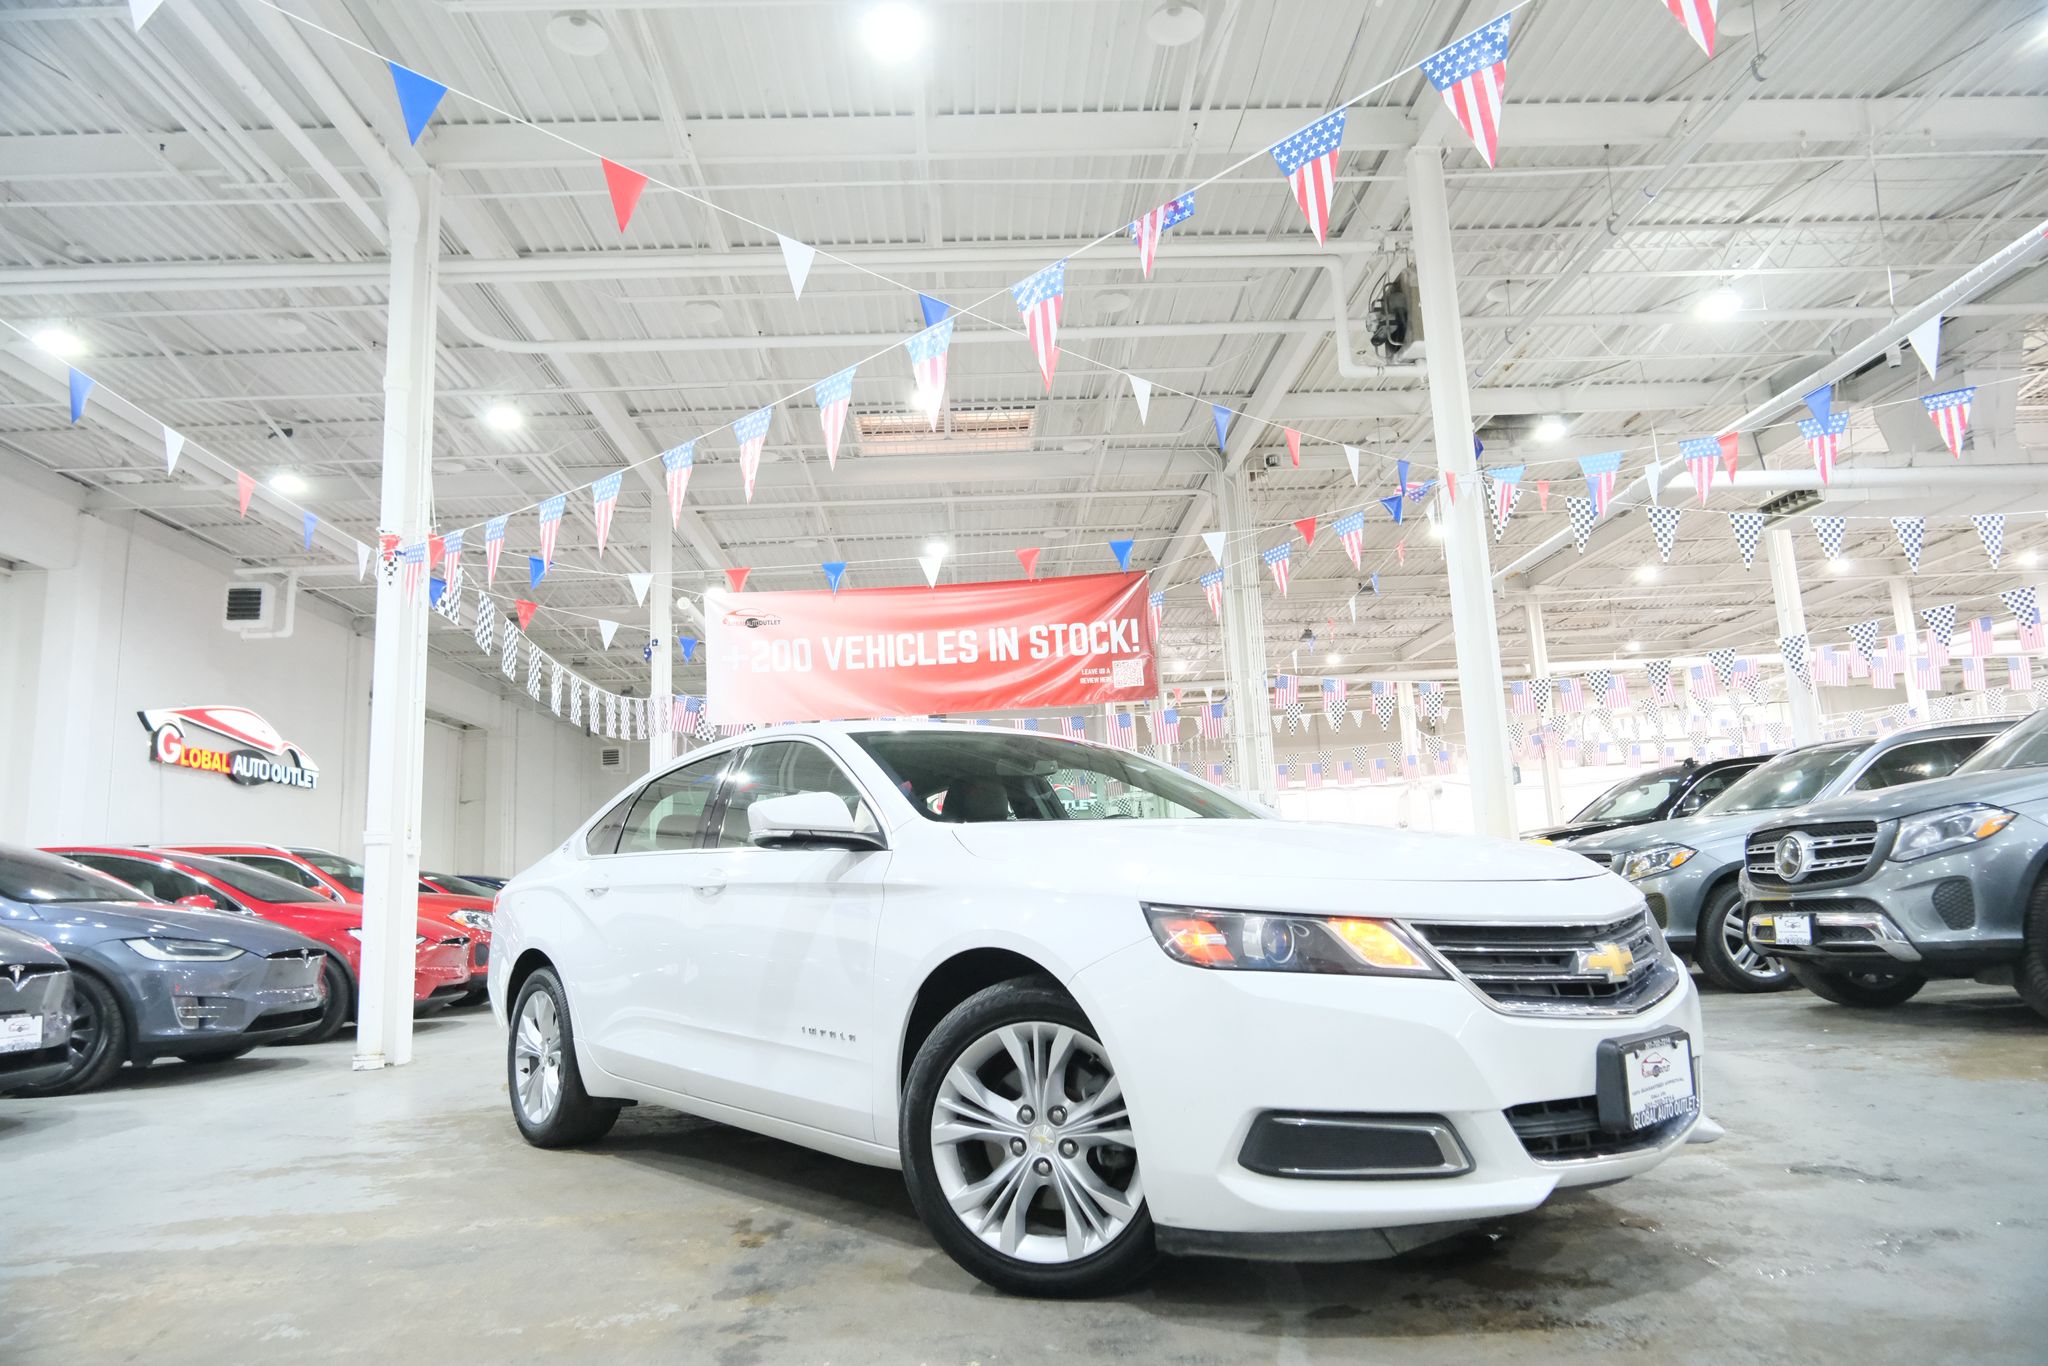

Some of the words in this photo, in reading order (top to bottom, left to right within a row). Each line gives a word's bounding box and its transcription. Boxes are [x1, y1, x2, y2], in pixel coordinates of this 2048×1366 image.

[721, 638, 813, 673] +200
[821, 630, 978, 671] VEHICLES
[988, 626, 1019, 662] IN
[1029, 618, 1140, 660] STOCK!
[156, 722, 230, 774] GLOBAL
[232, 754, 271, 781] AUTO
[271, 765, 319, 789] OUTLET
[1633, 1107, 1658, 1129] GLOBAL
[1657, 1102, 1674, 1121] AUTO
[1673, 1096, 1696, 1116] OUTLET
